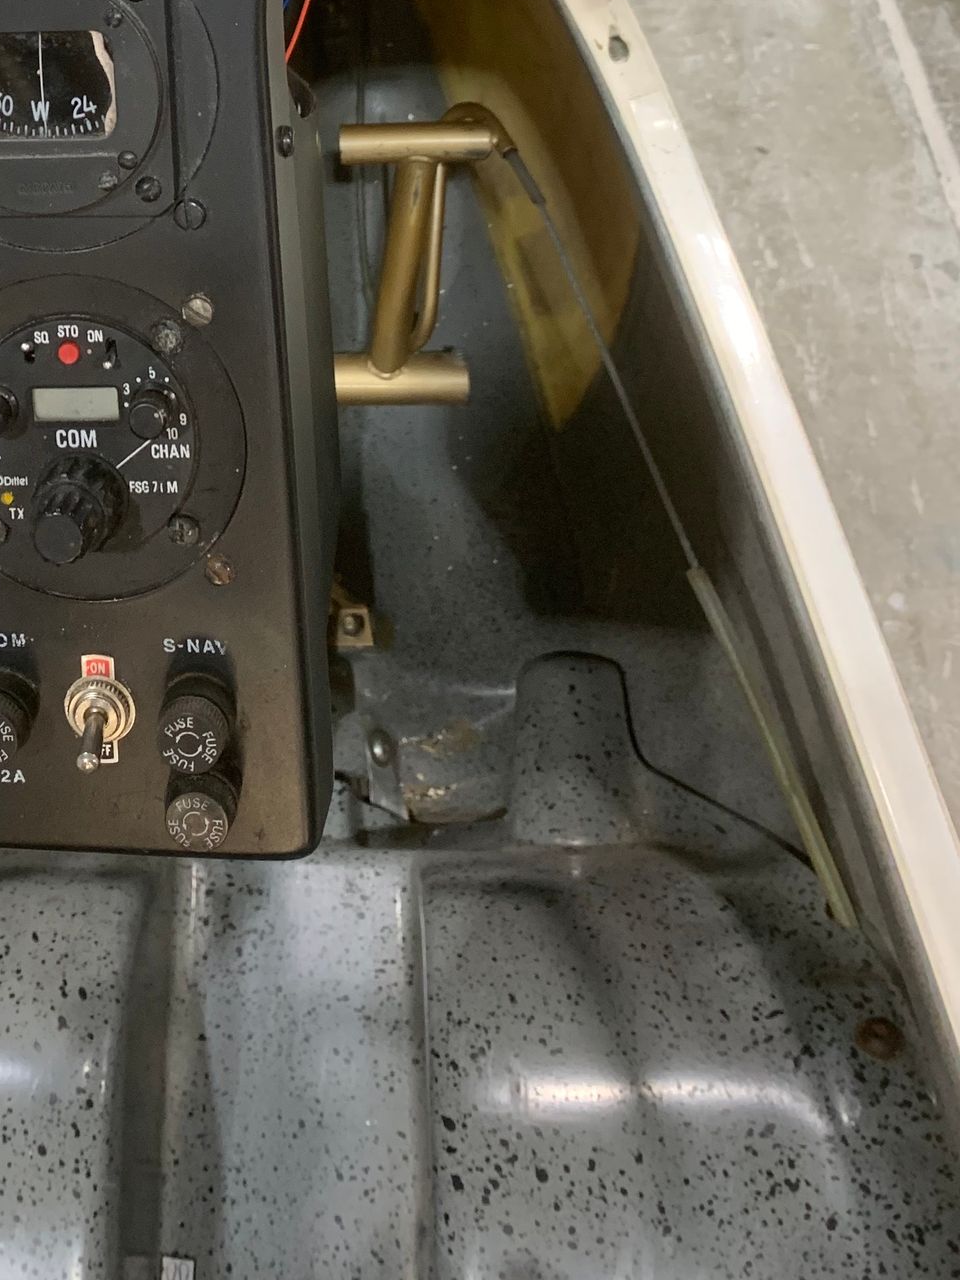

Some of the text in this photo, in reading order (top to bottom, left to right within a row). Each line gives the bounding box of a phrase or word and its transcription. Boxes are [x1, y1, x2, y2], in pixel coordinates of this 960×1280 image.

[30, 100, 50, 122] W
[70, 95, 97, 119] 24
[33, 330, 49, 344] SQ
[87, 330, 103, 343] ON
[148, 366, 156, 379] 5
[122, 383, 130, 395] 3
[179, 413, 187, 426] 9
[55, 429, 97, 448] COM
[166, 427, 178, 440] 10
[151, 444, 190, 459] CHAN
[129, 480, 150, 493] FSG
[8, 507, 24, 520] TX
[90, 662, 106, 674] ON
[164, 717, 194, 738] FUSE
[202, 730, 217, 764] FUSE
[162, 748, 195, 772] FUSE
[1, 769, 26, 783] 2A
[175, 797, 210, 812] FUSE
[167, 819, 191, 847] FUSE
[205, 819, 223, 849] FUSE
